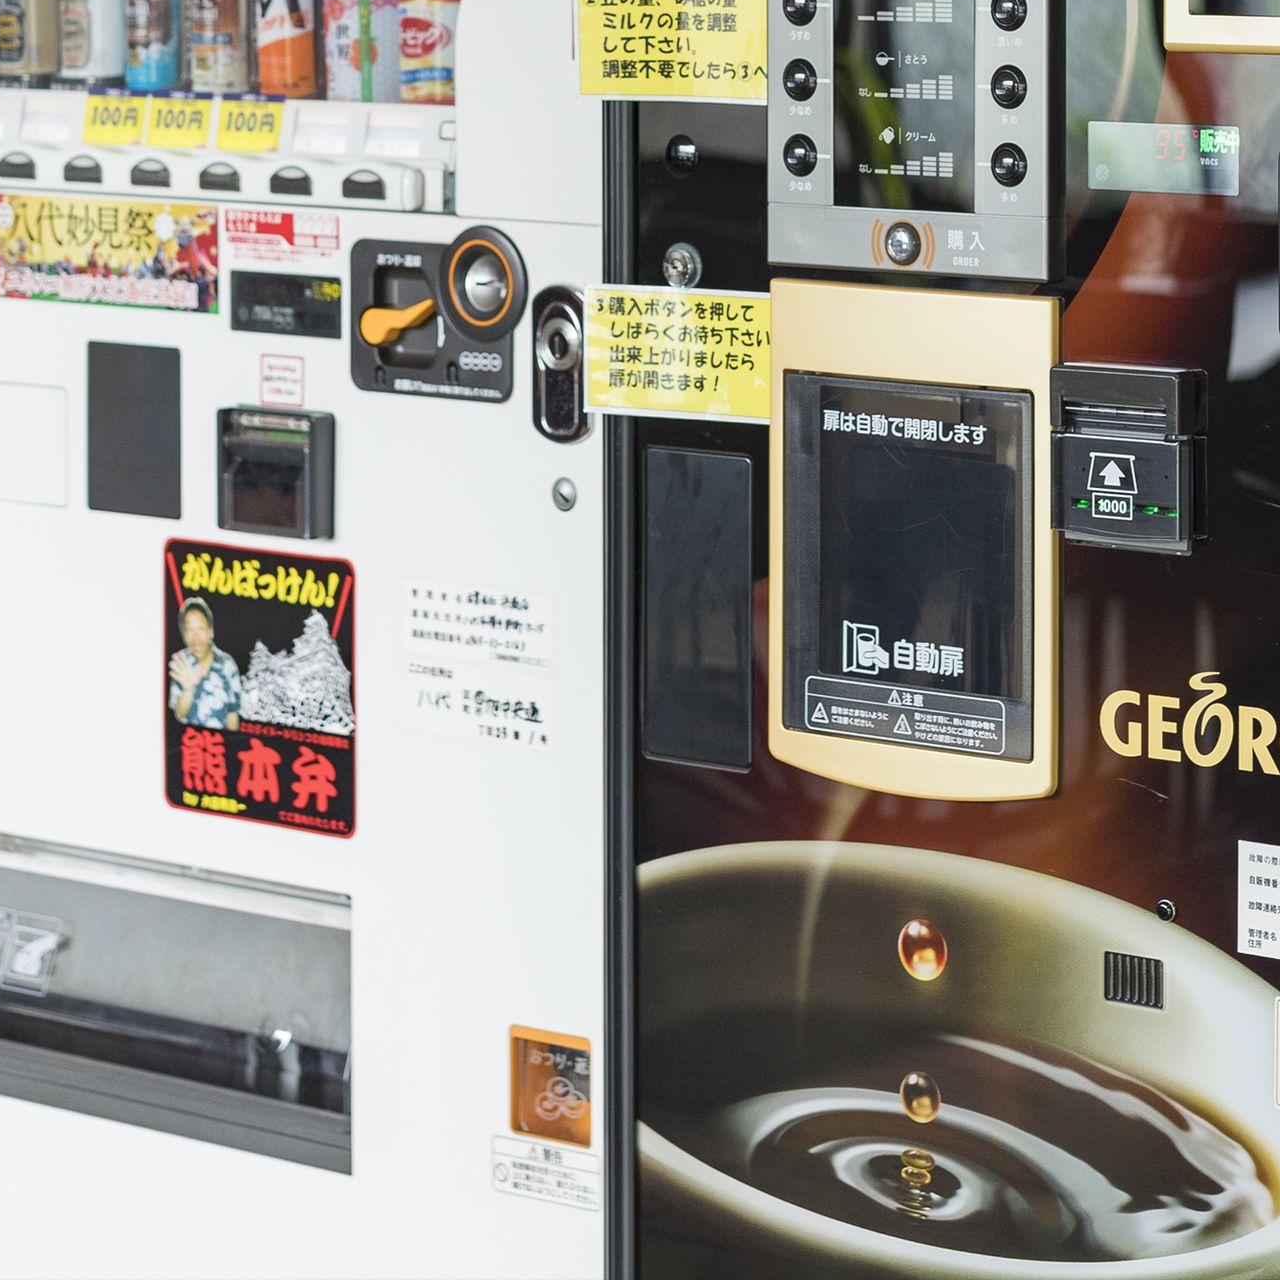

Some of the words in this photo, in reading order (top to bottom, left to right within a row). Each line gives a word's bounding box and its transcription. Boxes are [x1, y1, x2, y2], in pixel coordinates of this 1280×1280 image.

[603, 11, 738, 32] ミルクの量を調整
[789, 30, 811, 41] うすめ
[603, 36, 697, 56] して下さい。
[904, 54, 928, 66] さとう
[858, 87, 872, 98] なし
[91, 109, 138, 128] 100円
[156, 110, 202, 131] 100円
[789, 105, 812, 116] 少なめ
[227, 111, 275, 135] 100円
[905, 131, 937, 143] クリーム
[1199, 129, 1240, 155] 販売中
[858, 163, 872, 174] なし
[788, 181, 812, 192] 少なめ
[1000, 191, 1018, 203] 多め
[7, 202, 156, 252] 八代妙見祭
[947, 229, 985, 251] 購入
[953, 256, 980, 268] ORDER
[611, 321, 771, 347] しばらくお待ち下さい
[609, 345, 755, 370] 出来上がりましたら
[609, 368, 719, 391] 扉が開きます!
[823, 409, 987, 445] 扉は自動で開閉します
[181, 552, 340, 608] がんばっけん!
[893, 639, 964, 677] 自動扉
[902, 692, 924, 707] 注意
[181, 726, 337, 813] 熊本弁
[1248, 928, 1277, 942] 管理者名
[1248, 939, 1263, 949] 住所
